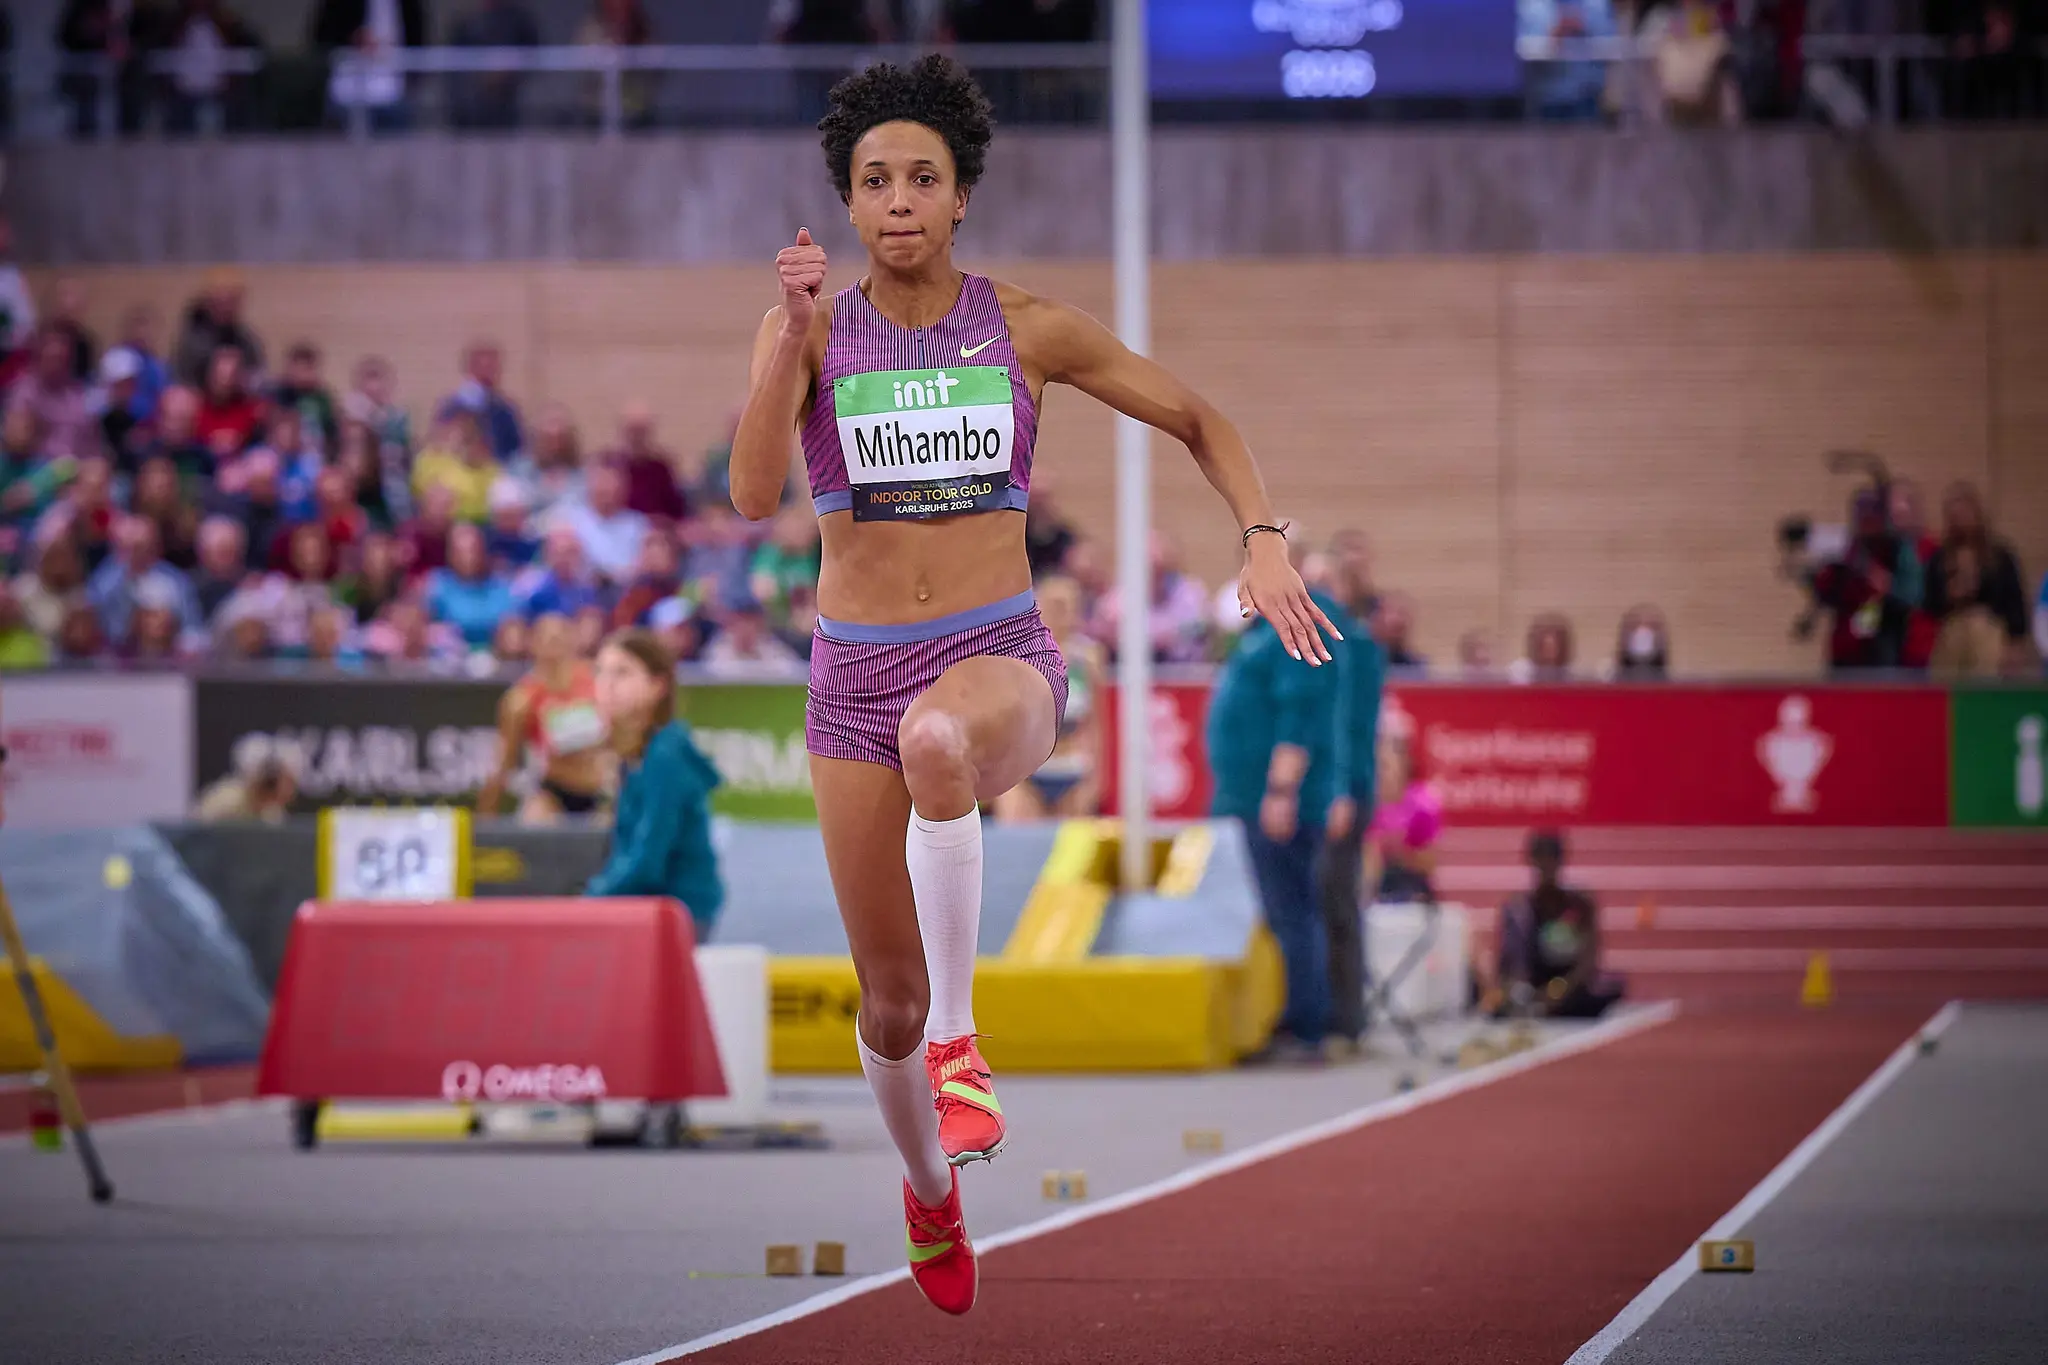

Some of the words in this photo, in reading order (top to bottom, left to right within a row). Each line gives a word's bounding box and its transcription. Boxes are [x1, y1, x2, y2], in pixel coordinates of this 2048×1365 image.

[893, 370, 960, 408] init
[854, 415, 1001, 468] Mihambo
[870, 490, 922, 504] INDOOR
[924, 487, 958, 501] TOUR
[960, 482, 993, 497] GOLD
[895, 503, 949, 514] KARLSRUHE
[950, 500, 974, 511] 2025
[483, 1062, 607, 1101] OMEGA
[940, 1055, 972, 1081] NIKE
